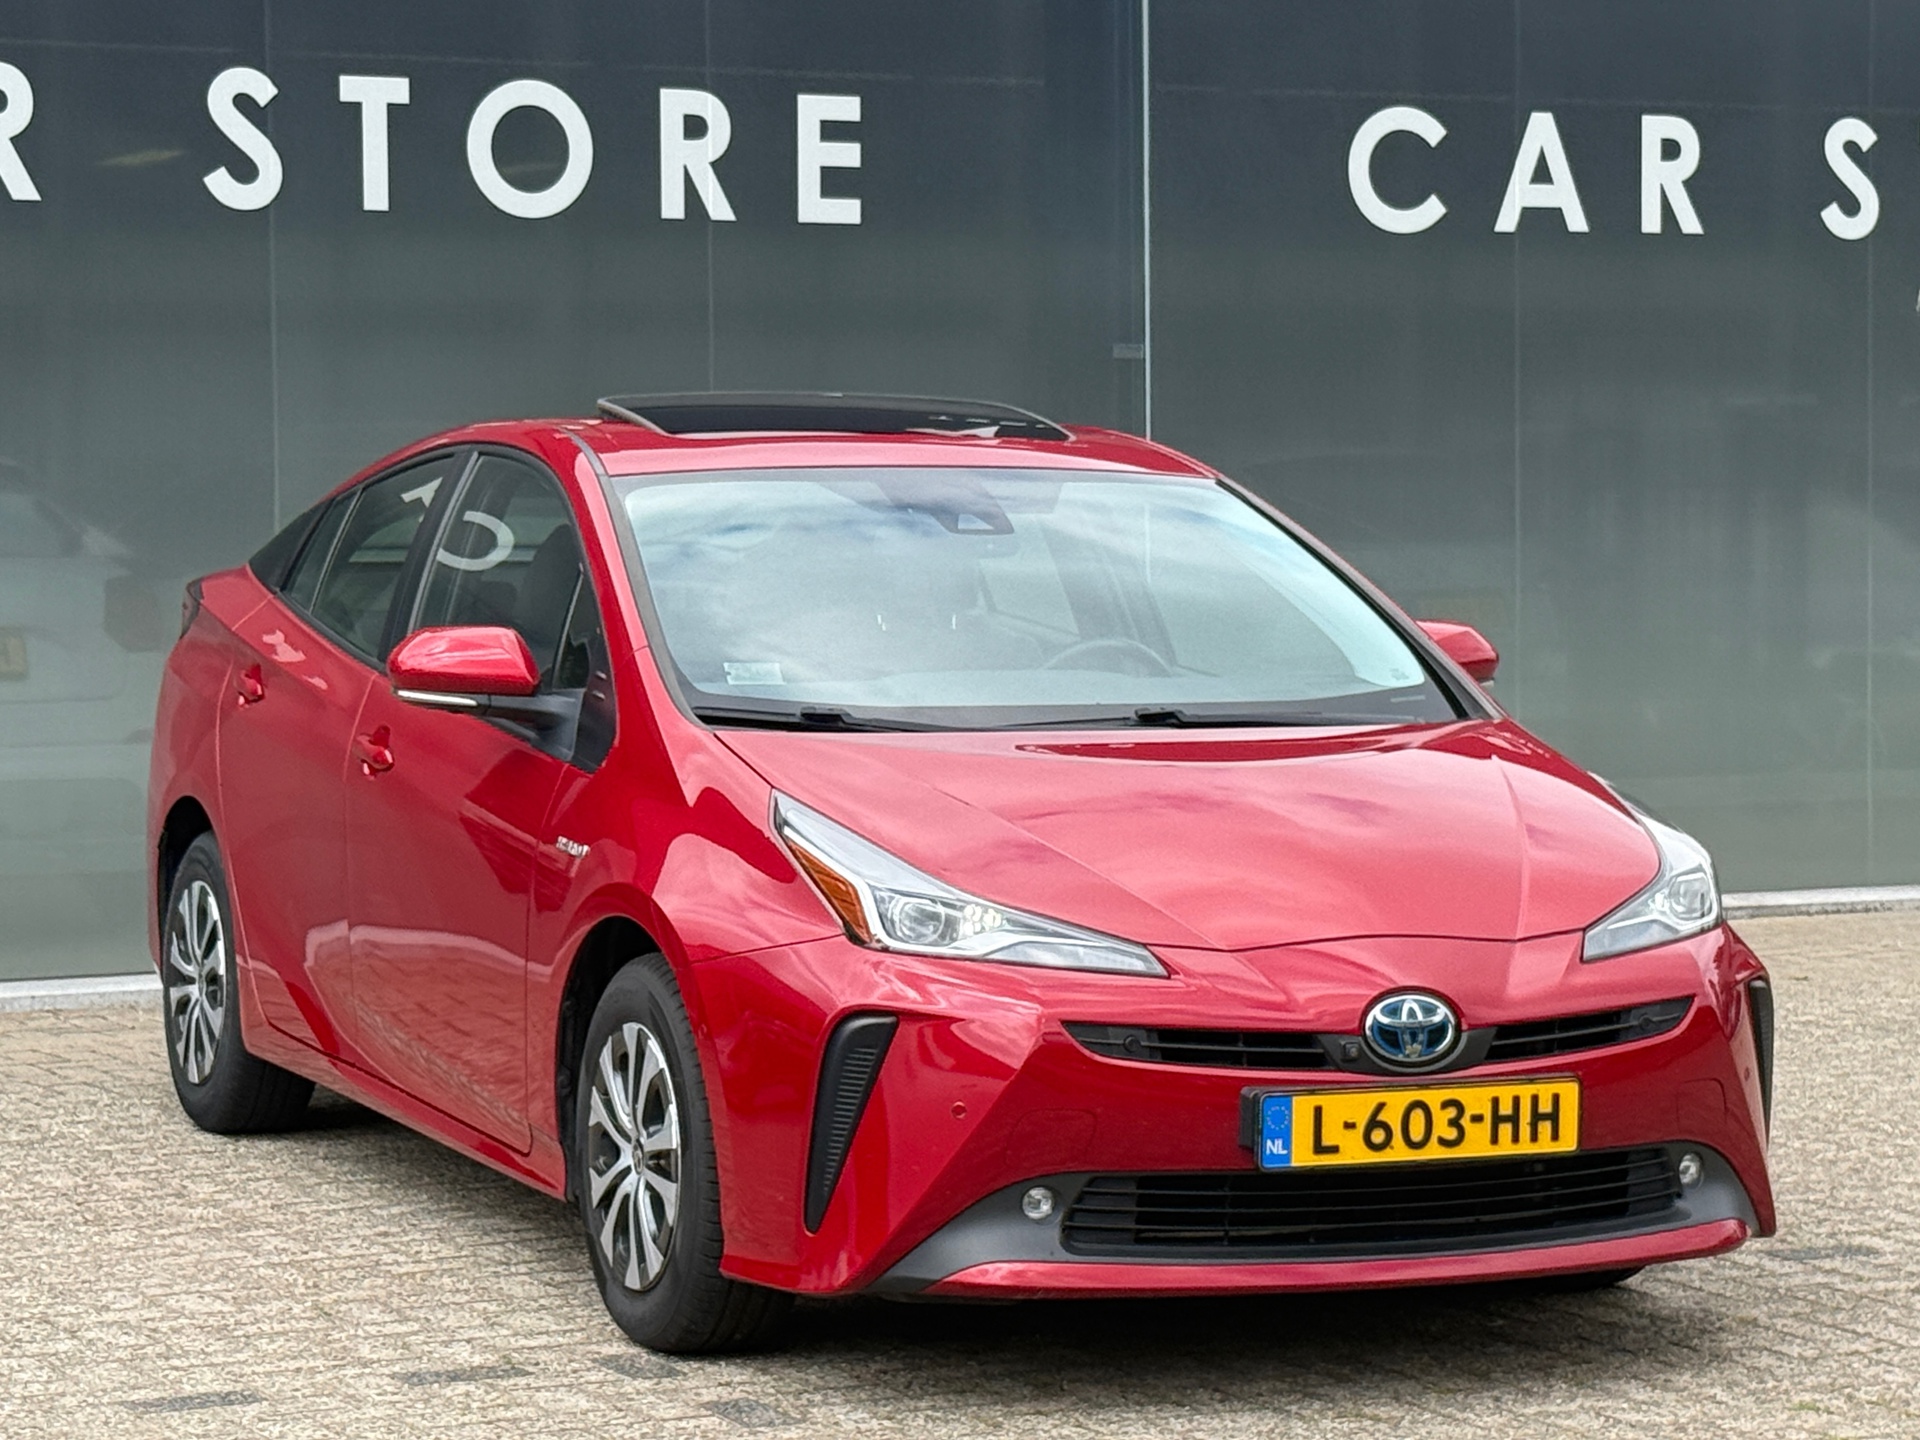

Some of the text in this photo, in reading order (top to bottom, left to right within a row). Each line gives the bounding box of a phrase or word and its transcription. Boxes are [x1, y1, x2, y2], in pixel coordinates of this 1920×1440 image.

[203, 66, 862, 225] STORE
[1348, 106, 1704, 234] CAR
[1265, 1138, 1289, 1156] NL
[1312, 1092, 1561, 1155] L-603-HH
